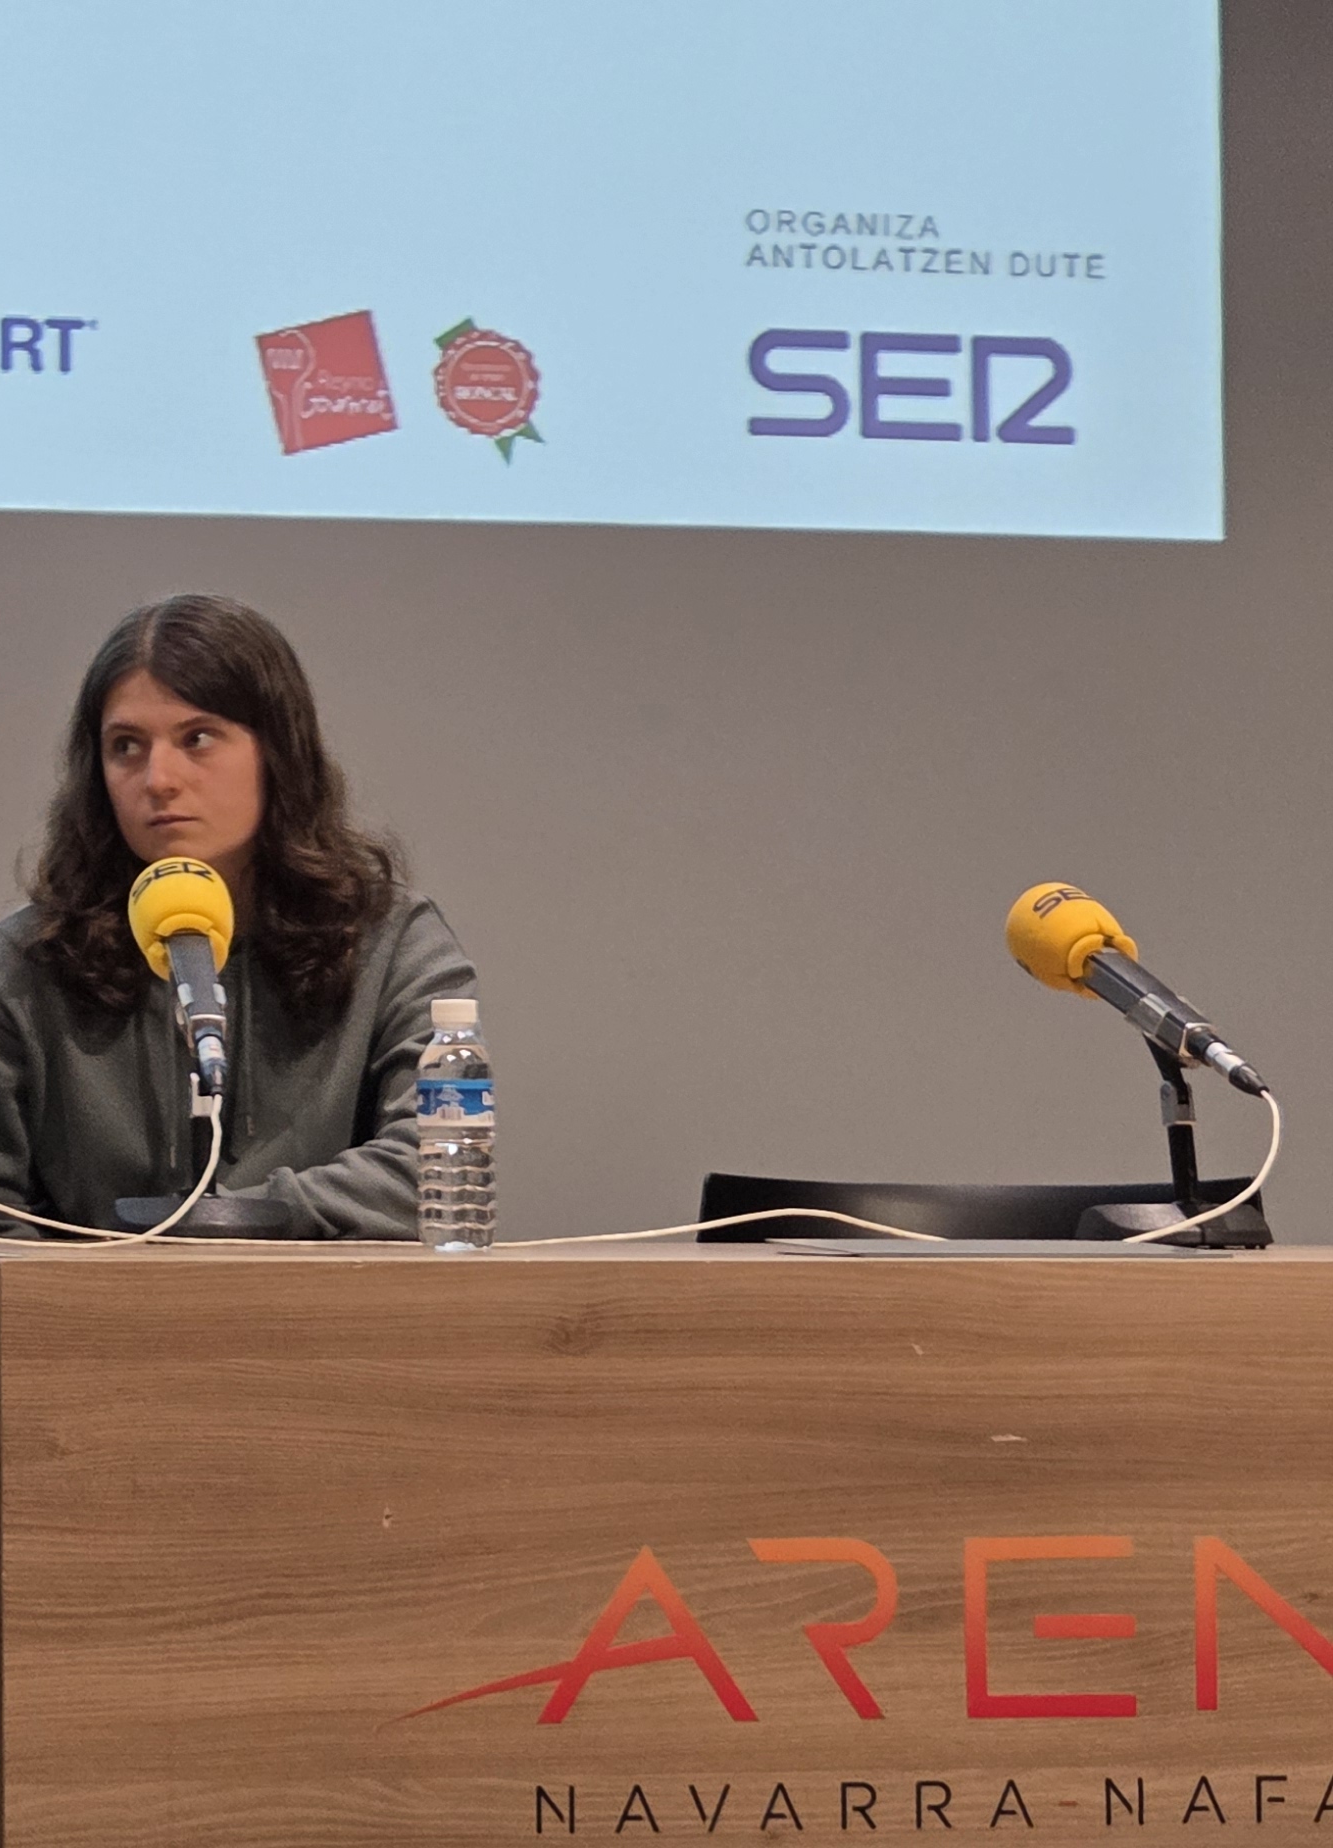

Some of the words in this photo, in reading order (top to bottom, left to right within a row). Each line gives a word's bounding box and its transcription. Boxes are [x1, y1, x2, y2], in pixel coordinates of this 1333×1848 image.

[745, 208, 940, 239] ORGANIZA
[745, 243, 991, 276] ANTOLATZEN
[1009, 250, 1106, 280] DUTE
[748, 328, 1076, 445] SER
[132, 861, 216, 906] SER
[1032, 887, 1091, 919] SE
